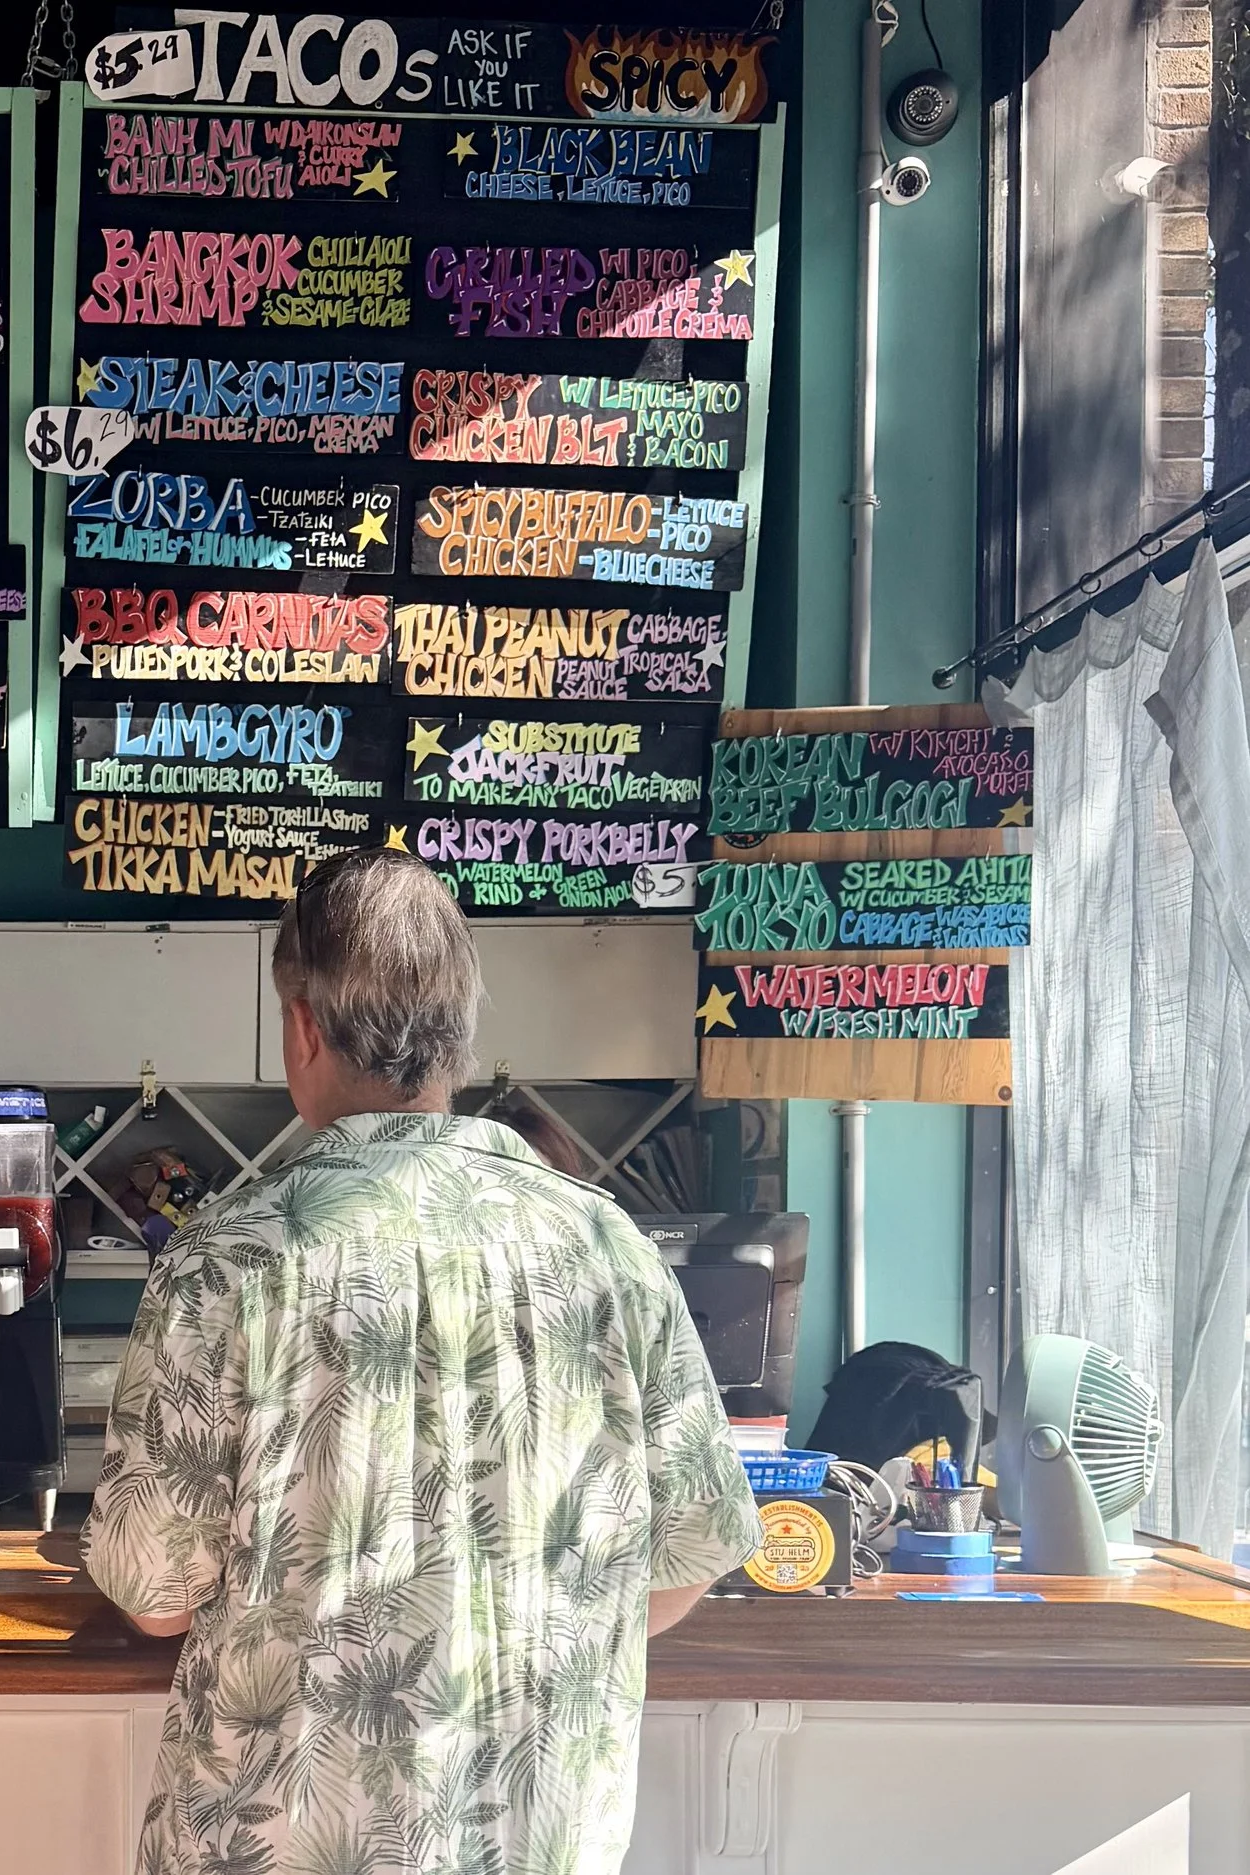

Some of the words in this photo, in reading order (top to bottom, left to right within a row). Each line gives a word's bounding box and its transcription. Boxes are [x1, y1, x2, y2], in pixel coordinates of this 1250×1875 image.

[448, 30, 497, 56] ASK
[505, 31, 532, 59] IF
[475, 59, 508, 78] YOU
[581, 50, 738, 112] SPICY
[444, 79, 502, 107] LIKE
[515, 83, 540, 111] IT
[104, 113, 198, 158] BANH
[208, 120, 254, 158] MI
[492, 126, 607, 176] BLACK
[608, 128, 713, 177] BEAN
[101, 228, 302, 290] BANGKOK
[424, 247, 597, 299] GRILLED
[79, 272, 259, 327] SHRIMP
[297, 268, 403, 297] CUCUMBER
[595, 277, 701, 311] CABBAGE
[449, 289, 571, 337] FISH
[85, 356, 248, 415] STEAK
[253, 360, 405, 416] CHEESE
[413, 368, 542, 421] CRISPY
[28, 408, 128, 467] $6.29
[307, 414, 395, 439] MEXICAN
[314, 434, 379, 454] CREMA
[409, 412, 553, 463] CHICKEN
[550, 413, 627, 467] BLT
[635, 409, 704, 440] MAYO
[642, 437, 729, 470] BACON
[67, 469, 256, 534] ZORBA
[352, 492, 391, 510] PICO
[190, 532, 293, 570] HUMMUS
[439, 534, 579, 577] CHICKEN
[72, 586, 191, 645] BBQ
[186, 591, 390, 655] CARNITAS
[393, 604, 479, 663] THAI
[483, 606, 630, 660] PEANUT
[245, 648, 380, 682] COLESLAW
[404, 652, 556, 698] CHICKEN
[556, 659, 619, 684] PEANUT
[618, 645, 696, 676] TROPICAL
[644, 667, 711, 693] SALSA
[558, 677, 628, 700] SAUCE
[115, 702, 237, 764] LAMB
[237, 704, 344, 764] GYRO
[481, 720, 643, 756] SUBSTITUTE
[448, 735, 627, 788] JACKFRUIT
[711, 733, 869, 787] KOREAN
[414, 772, 443, 799] TO
[449, 780, 515, 806] MAKE
[561, 781, 615, 810] TACO
[612, 771, 703, 804] VEGETARIAN
[707, 777, 808, 834] BEEF
[810, 772, 974, 832] BULGOGI
[74, 799, 214, 848] CHICKEN
[417, 818, 538, 865] CRISPY
[68, 840, 184, 893] TIKKA
[456, 861, 563, 884] WATERMELON
[698, 860, 829, 907] TUNA
[840, 859, 951, 890] SEARED
[474, 882, 525, 907] RIND
[694, 903, 836, 950] TOKYO
[840, 908, 937, 947] CABBAGE
[735, 965, 989, 1007] WATERMELON
[816, 1008, 899, 1038] FRESH
[901, 1006, 978, 1038] MINT
[664, 1230, 684, 1239] NCR
[788, 1548, 810, 1556] HELM
